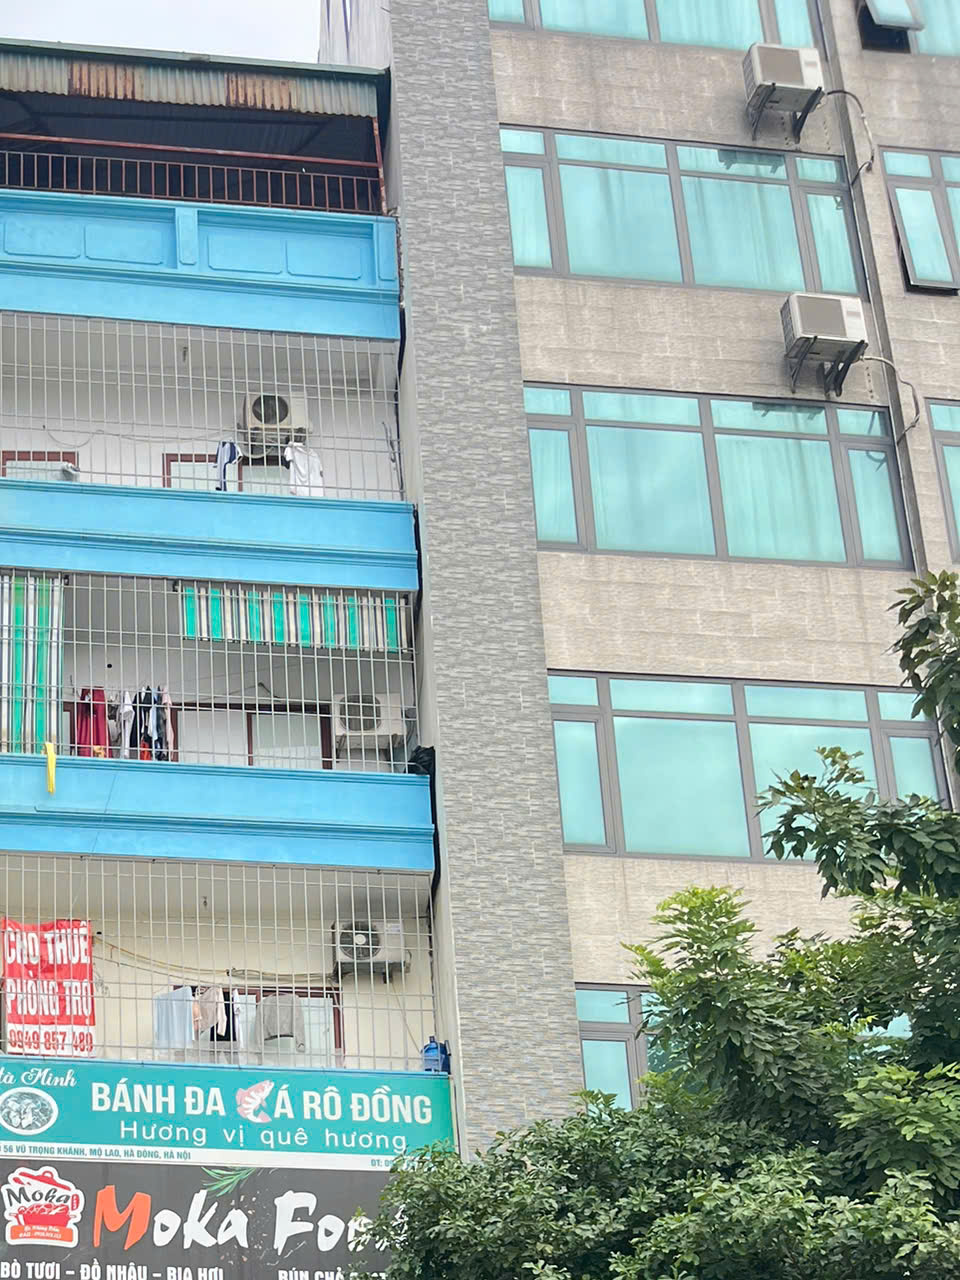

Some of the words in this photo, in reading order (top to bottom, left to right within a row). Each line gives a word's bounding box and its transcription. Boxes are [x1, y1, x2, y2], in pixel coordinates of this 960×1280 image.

[4, 926, 39, 964] CHO
[44, 920, 90, 965] THUÊ
[6, 970, 59, 1016] PHÒNG
[63, 979, 92, 1025] TRỌ
[20, 1067, 77, 1088] Minh
[91, 1078, 175, 1116] BÁNH
[183, 1086, 226, 1117] ĐA
[303, 1085, 342, 1121] RÔ
[350, 1084, 432, 1125] ĐỒNG
[3, 1144, 14, 1153] 56
[28, 1145, 55, 1155] TRỌNG
[123, 1148, 135, 1158] HÀ
[163, 1149, 175, 1160] HÀ
[176, 1149, 192, 1161] NỘI
[120, 1119, 207, 1146] Hương
[223, 1125, 244, 1147] vị
[260, 1127, 308, 1149] quê
[324, 1128, 407, 1154] hương
[6, 1186, 71, 1207] Moka
[93, 1184, 249, 1250] Moka
[0, 1258, 21, 1279] BÒ
[26, 1262, 61, 1280] TƯƠI
